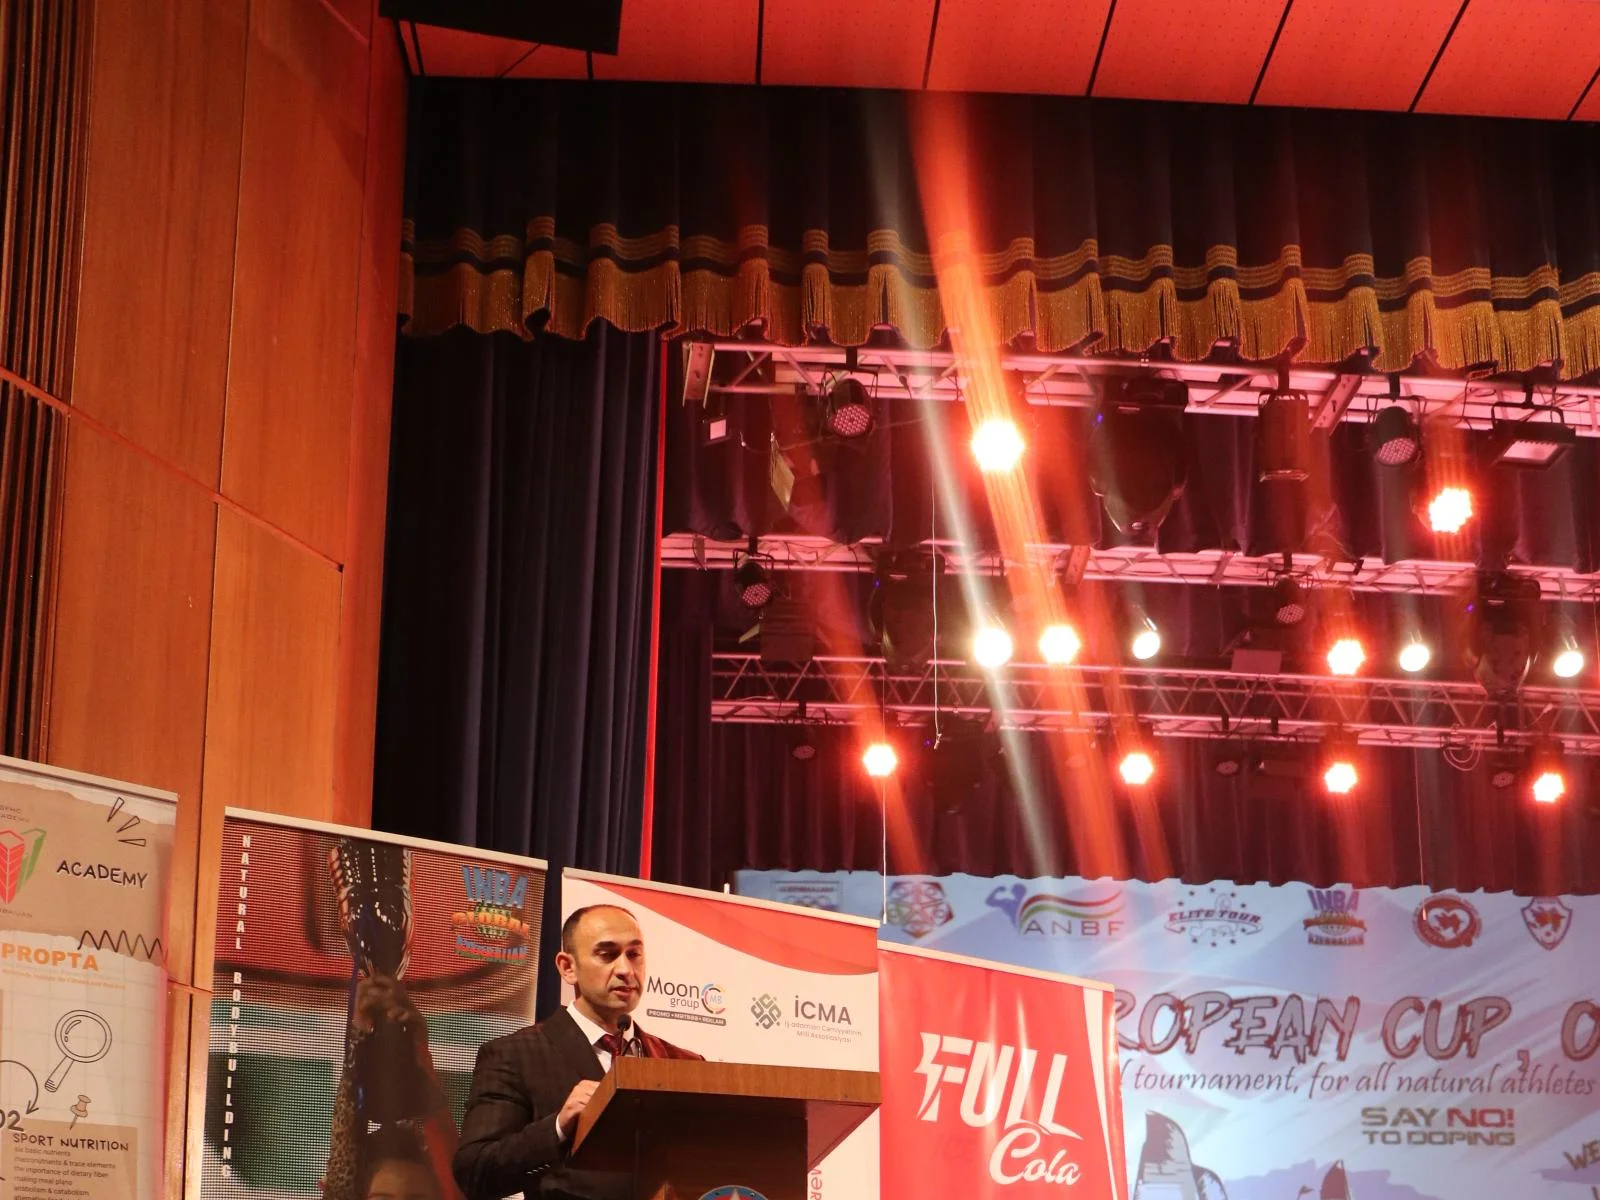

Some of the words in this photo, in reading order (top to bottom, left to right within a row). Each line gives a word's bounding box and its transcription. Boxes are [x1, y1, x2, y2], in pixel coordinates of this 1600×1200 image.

[56, 859, 149, 888] ACADEMY
[236, 835, 251, 950] NATURAL
[462, 865, 529, 909] INBA
[1307, 889, 1360, 912] INBA
[1023, 919, 1124, 936] ANBF
[1168, 909, 1215, 923] ELITE
[1219, 910, 1261, 924] TOUR
[1, 942, 99, 971] PROPTA
[647, 976, 700, 999] Moon
[648, 1010, 671, 1018] PROMO
[670, 998, 700, 1010] group
[794, 995, 852, 1025] İCMA
[222, 971, 243, 1179] BODYBUILDING
[912, 1031, 1084, 1141] FULL
[1134, 1063, 1299, 1094] tournament,
[1309, 1061, 1349, 1099] for
[1356, 1065, 1391, 1092] all
[1397, 1065, 1500, 1094] natural
[1502, 1065, 1596, 1096] athletes
[1361, 1108, 1440, 1128] SAY
[1446, 1107, 1515, 1129] NO!
[12, 1133, 54, 1146] SPORT
[60, 1139, 129, 1151] NUTRITION
[1362, 1132, 1403, 1146] TO
[1406, 1132, 1516, 1146] DOPING
[989, 1127, 1081, 1186] Cola
[26, 1167, 61, 1176] importance
[71, 1169, 92, 1178] dietary
